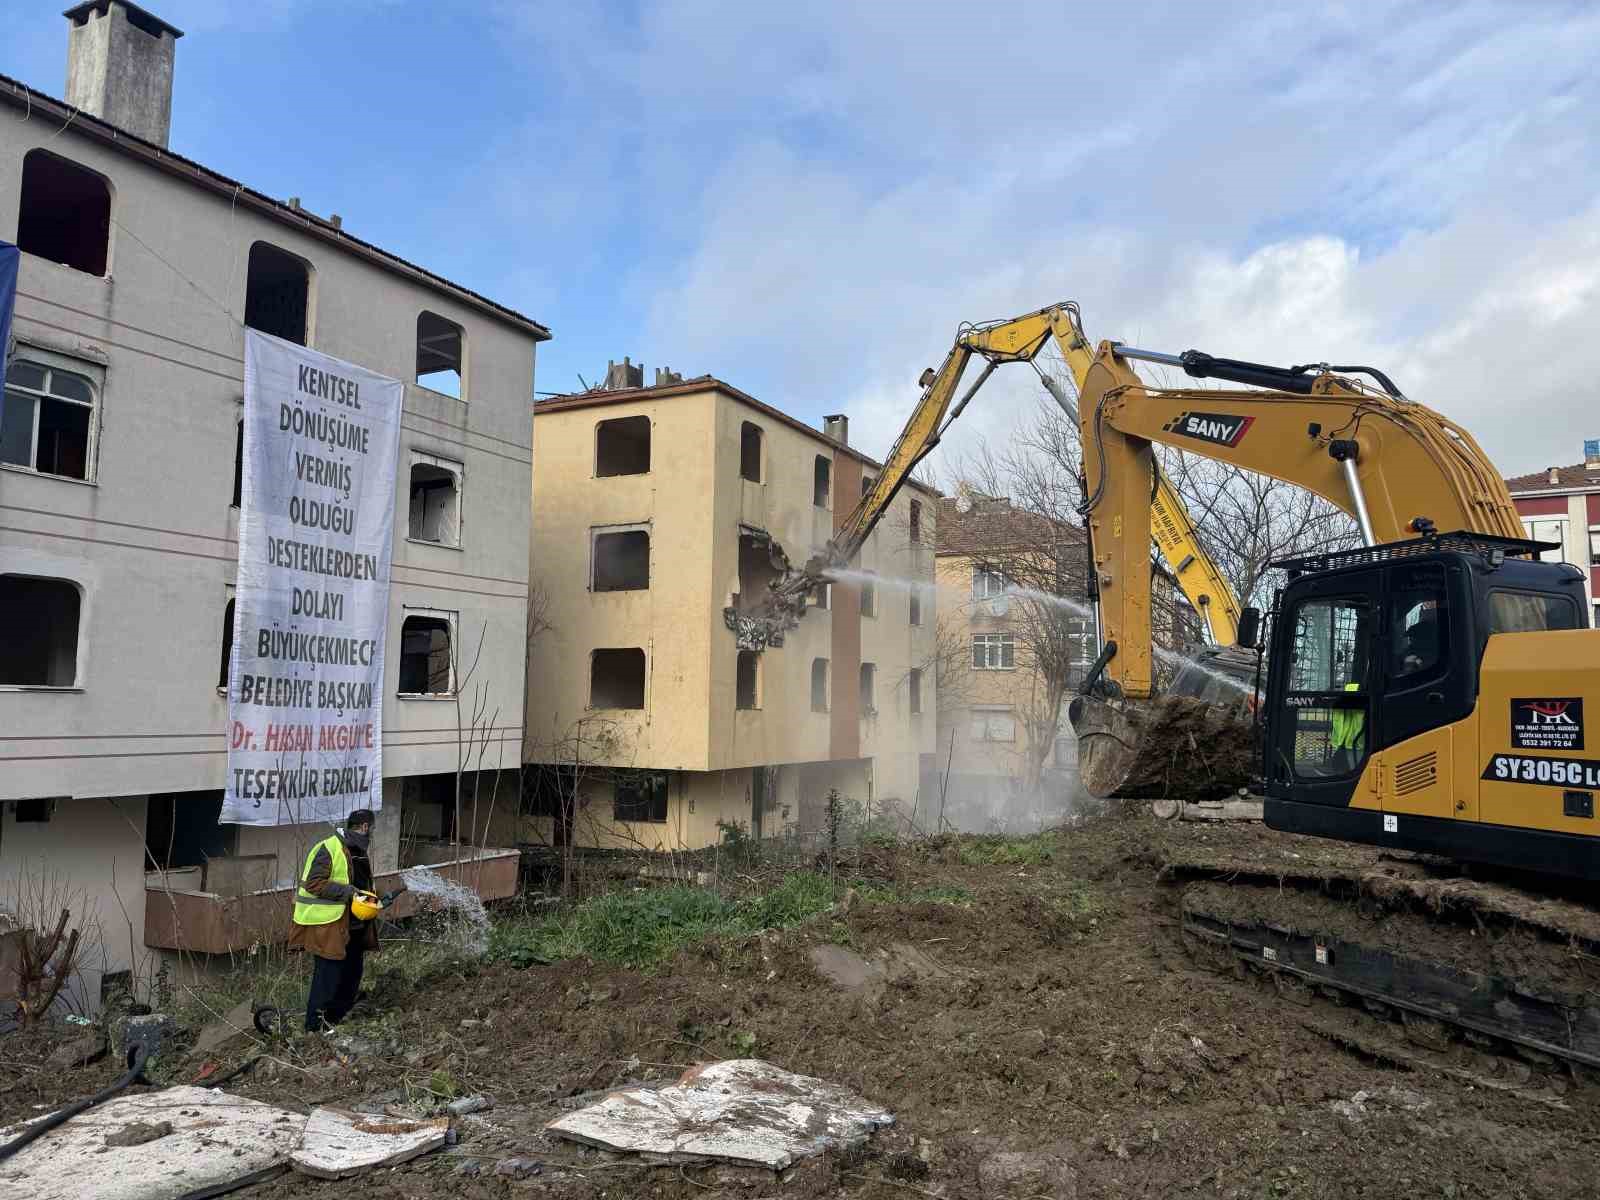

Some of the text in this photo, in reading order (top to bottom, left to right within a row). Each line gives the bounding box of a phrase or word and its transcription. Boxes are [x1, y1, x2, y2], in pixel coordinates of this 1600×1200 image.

[299, 364, 361, 410] KENTSEL
[279, 399, 369, 454] DÖNÜŞÜME
[1186, 416, 1233, 441] SANY
[296, 451, 352, 499] VERMİŞ
[289, 495, 354, 535] OLDUĞU
[268, 535, 377, 581] DESTEKLERDEN
[292, 586, 344, 621] DOLAYI
[240, 671, 376, 717] BELEDİYE BAŞKAN
[1286, 697, 1315, 706] SANY
[231, 720, 257, 751] Dr.
[264, 723, 314, 752] HASAN
[234, 759, 369, 808] TEŞEKKÜR EDERİZ
[1495, 757, 1600, 786] SY305C L
